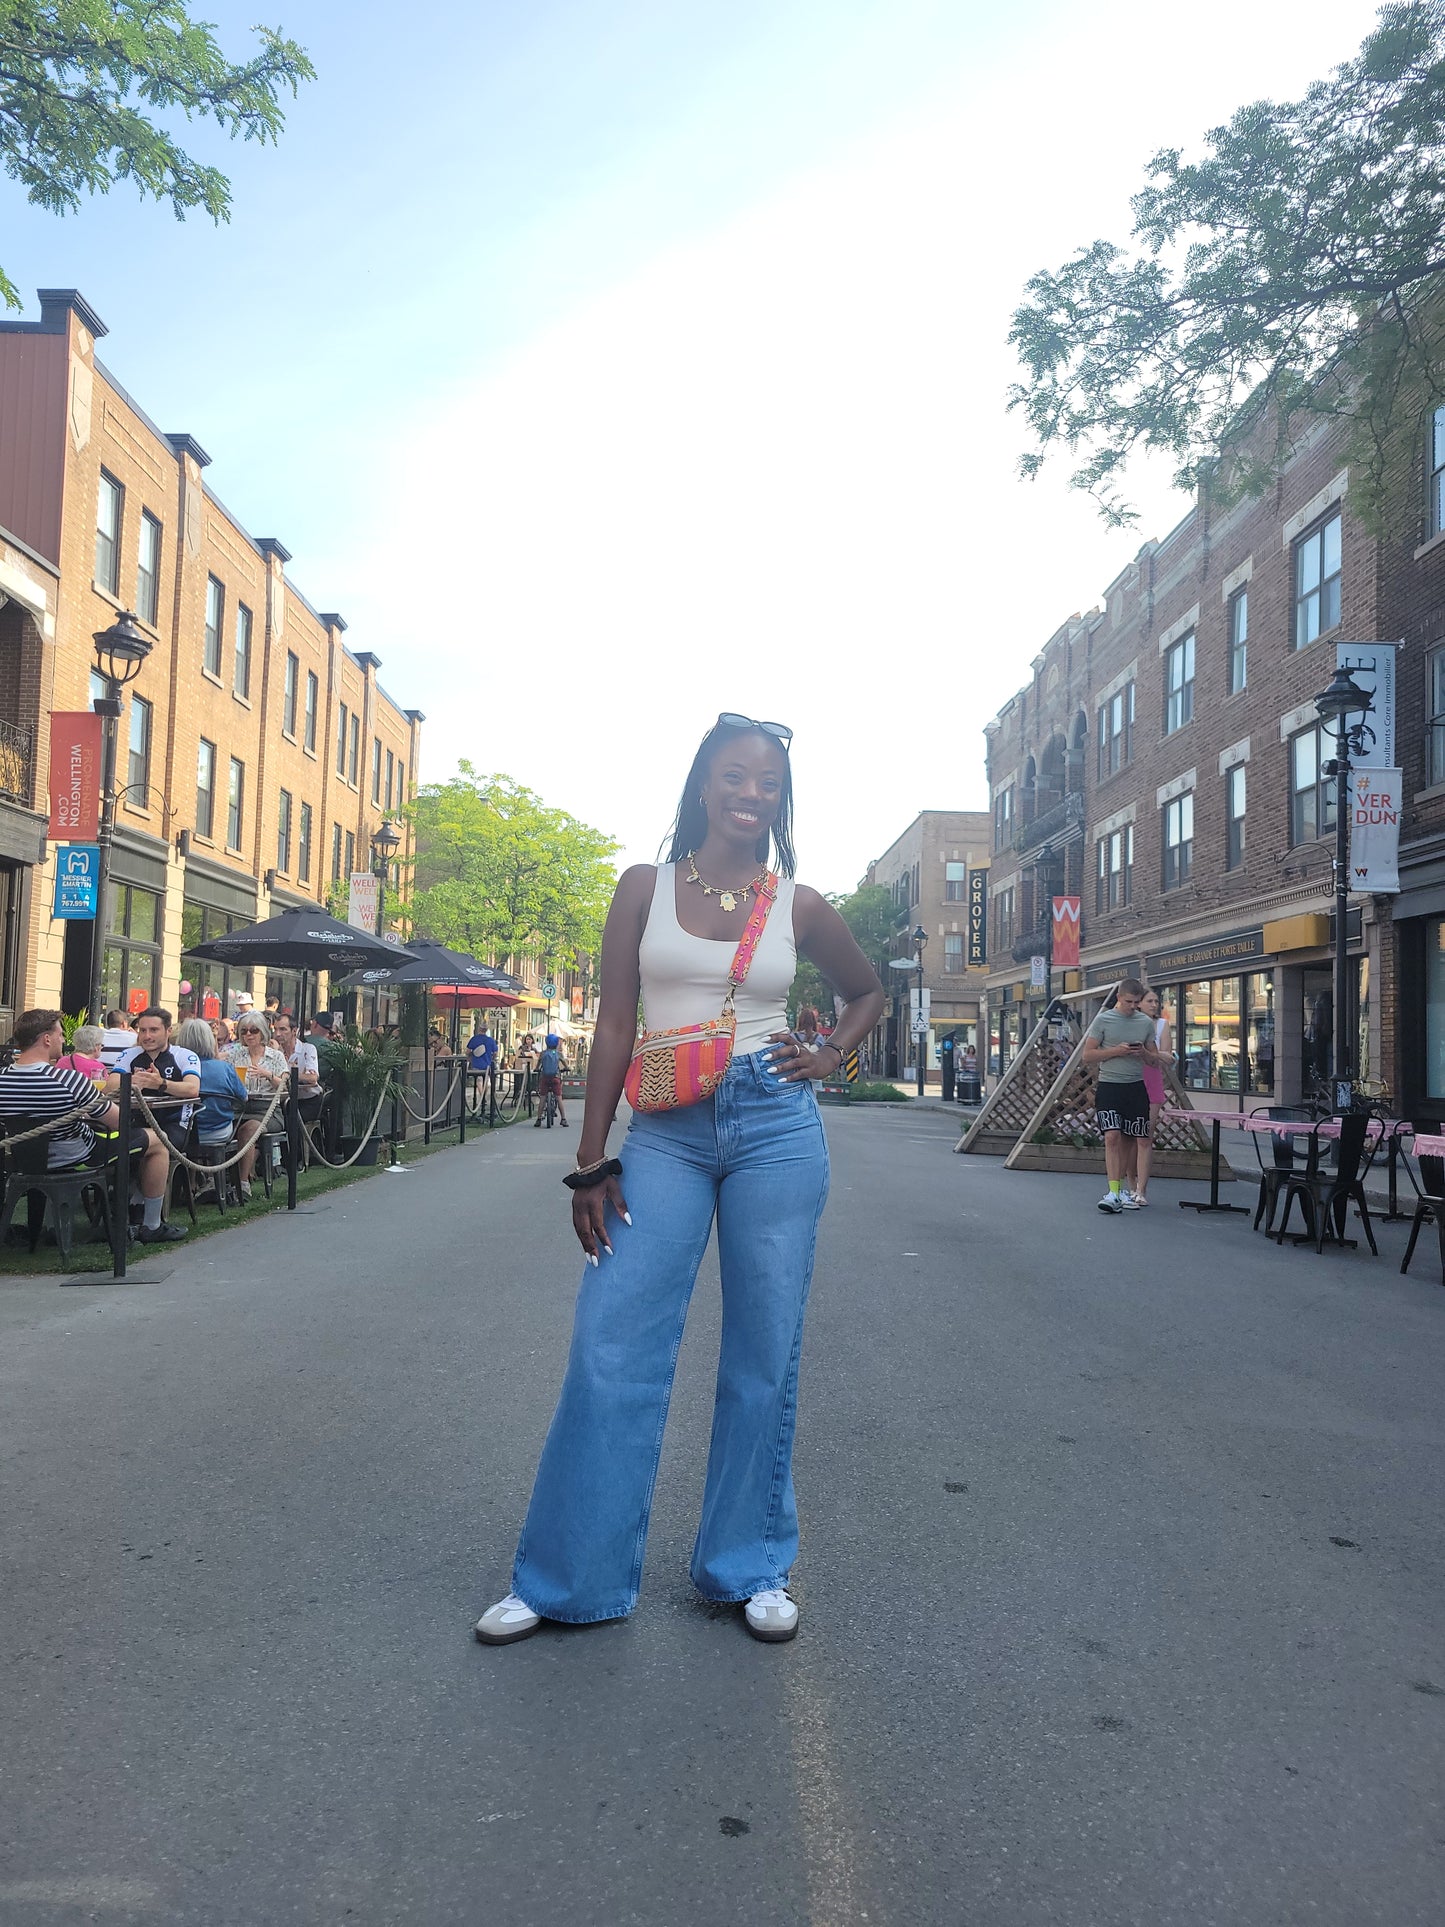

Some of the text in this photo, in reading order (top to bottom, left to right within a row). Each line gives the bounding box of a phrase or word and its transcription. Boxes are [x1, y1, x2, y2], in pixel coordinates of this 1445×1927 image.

[69, 743, 82, 827] WELLINGTON
[81, 748, 94, 828] PROMENADE
[57, 794, 69, 827] .COM
[1357, 793, 1393, 808] VER
[1355, 810, 1398, 825] DUN
[352, 879, 377, 887] WELL
[972, 877, 983, 958] GROVER
[1194, 950, 1212, 962] GRANDE
[1213, 947, 1220, 959] ET
[1220, 944, 1237, 957] FORTE
[1237, 940, 1256, 953] TAILLE
